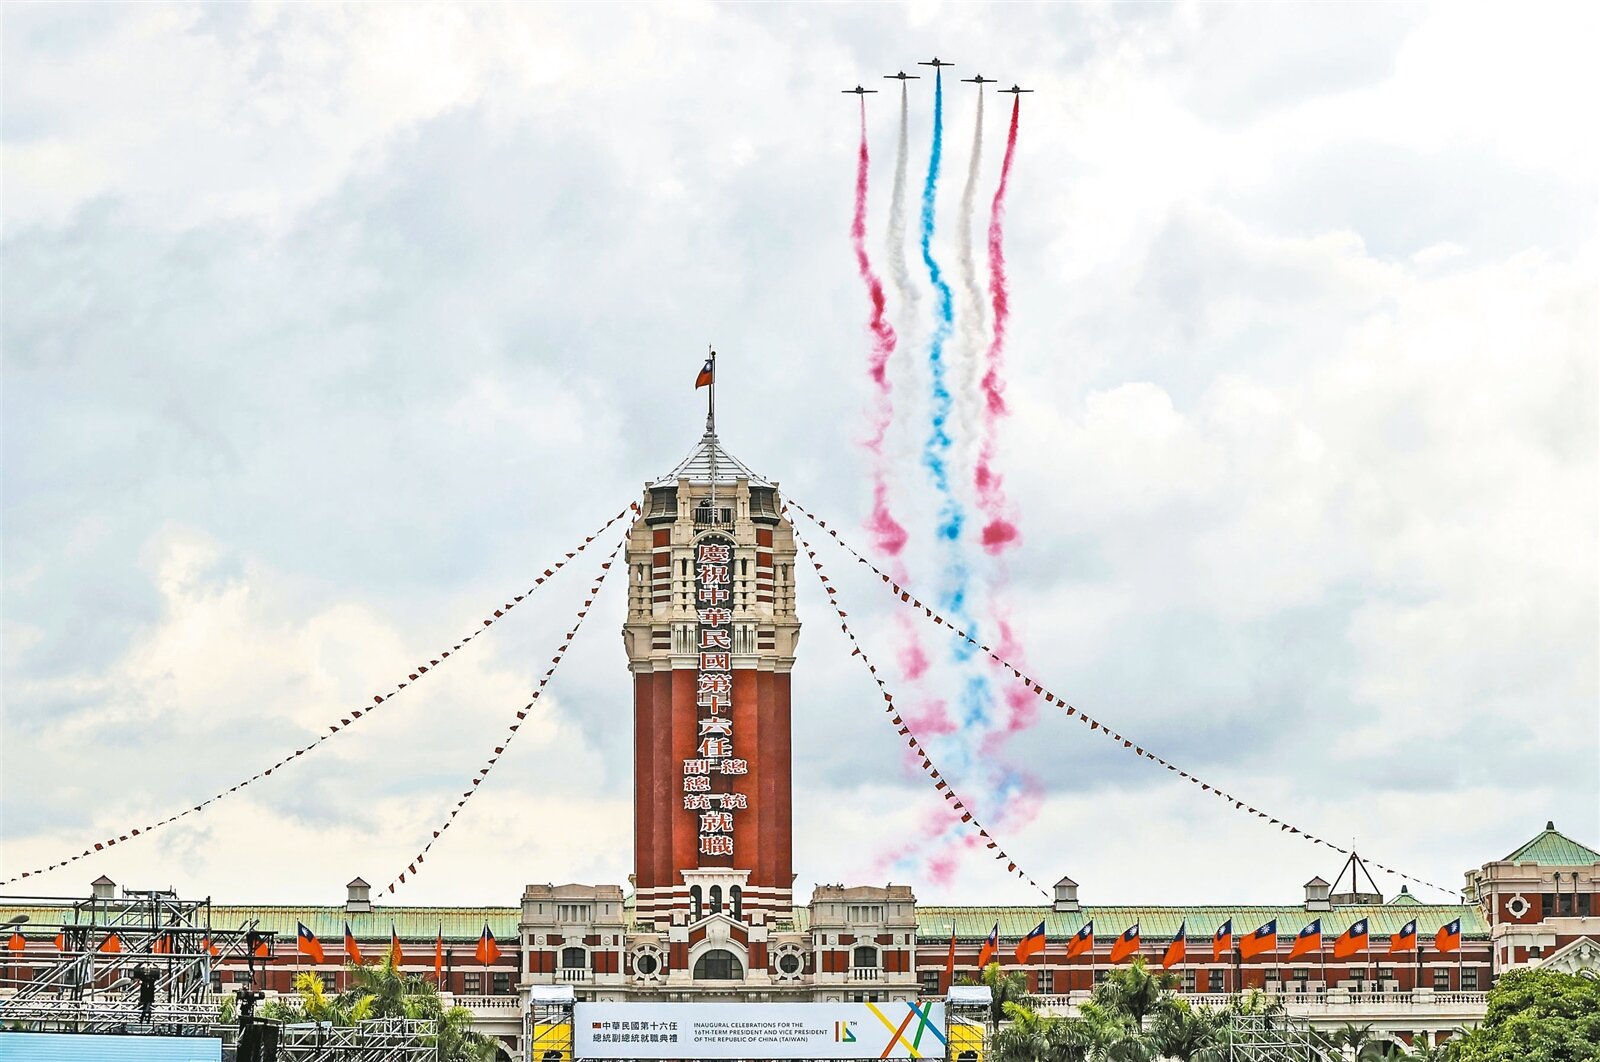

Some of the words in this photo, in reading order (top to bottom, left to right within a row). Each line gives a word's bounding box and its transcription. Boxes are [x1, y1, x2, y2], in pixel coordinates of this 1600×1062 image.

[602, 1021, 678, 1031] 中華民國第十六任
[592, 1033, 678, 1043] 總統副總統就職典禮
